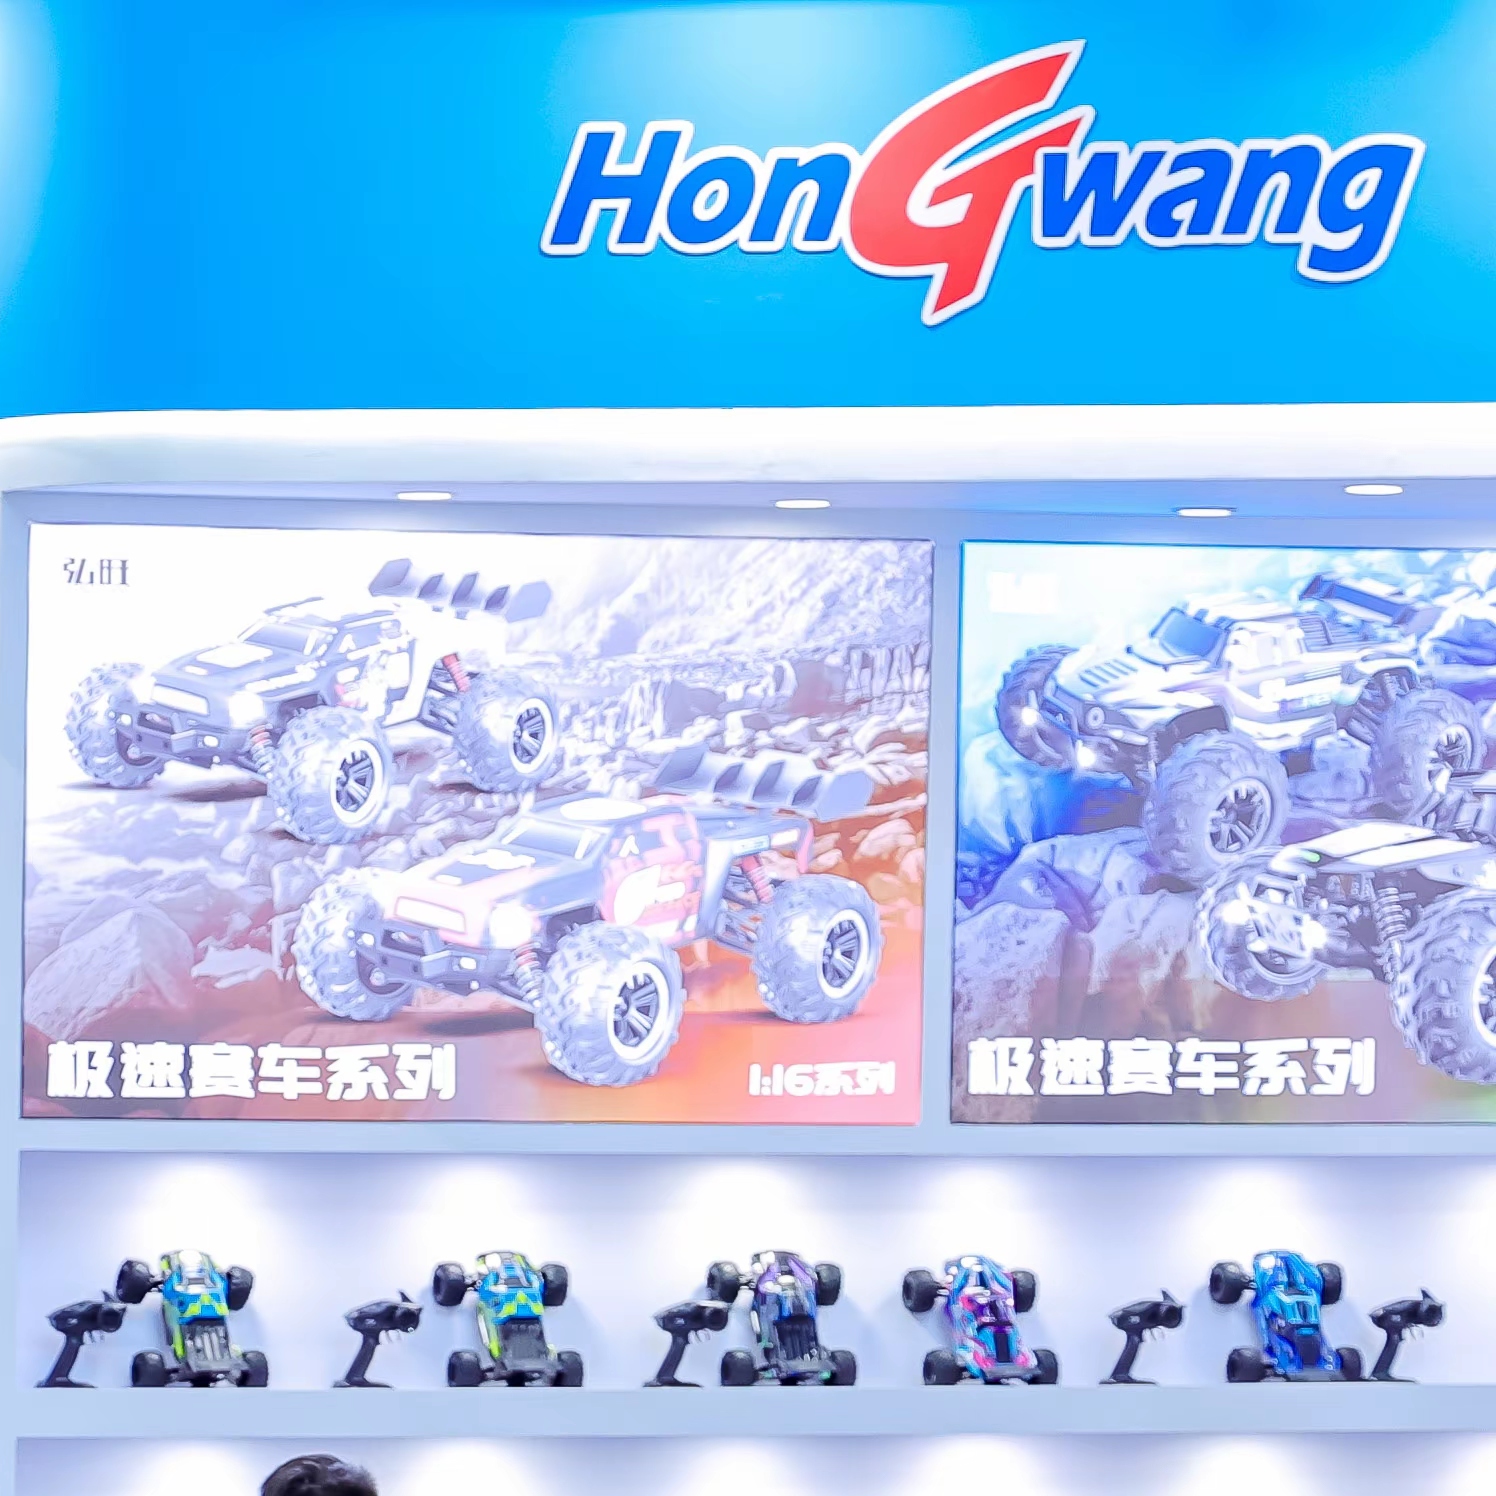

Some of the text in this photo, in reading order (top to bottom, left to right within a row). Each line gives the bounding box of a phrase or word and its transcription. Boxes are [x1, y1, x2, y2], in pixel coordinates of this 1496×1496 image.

[540, 39, 1425, 326] HonGwang
[47, 1041, 456, 1101] 极速赛车系列
[967, 1037, 1376, 1097] 极速赛车系列
